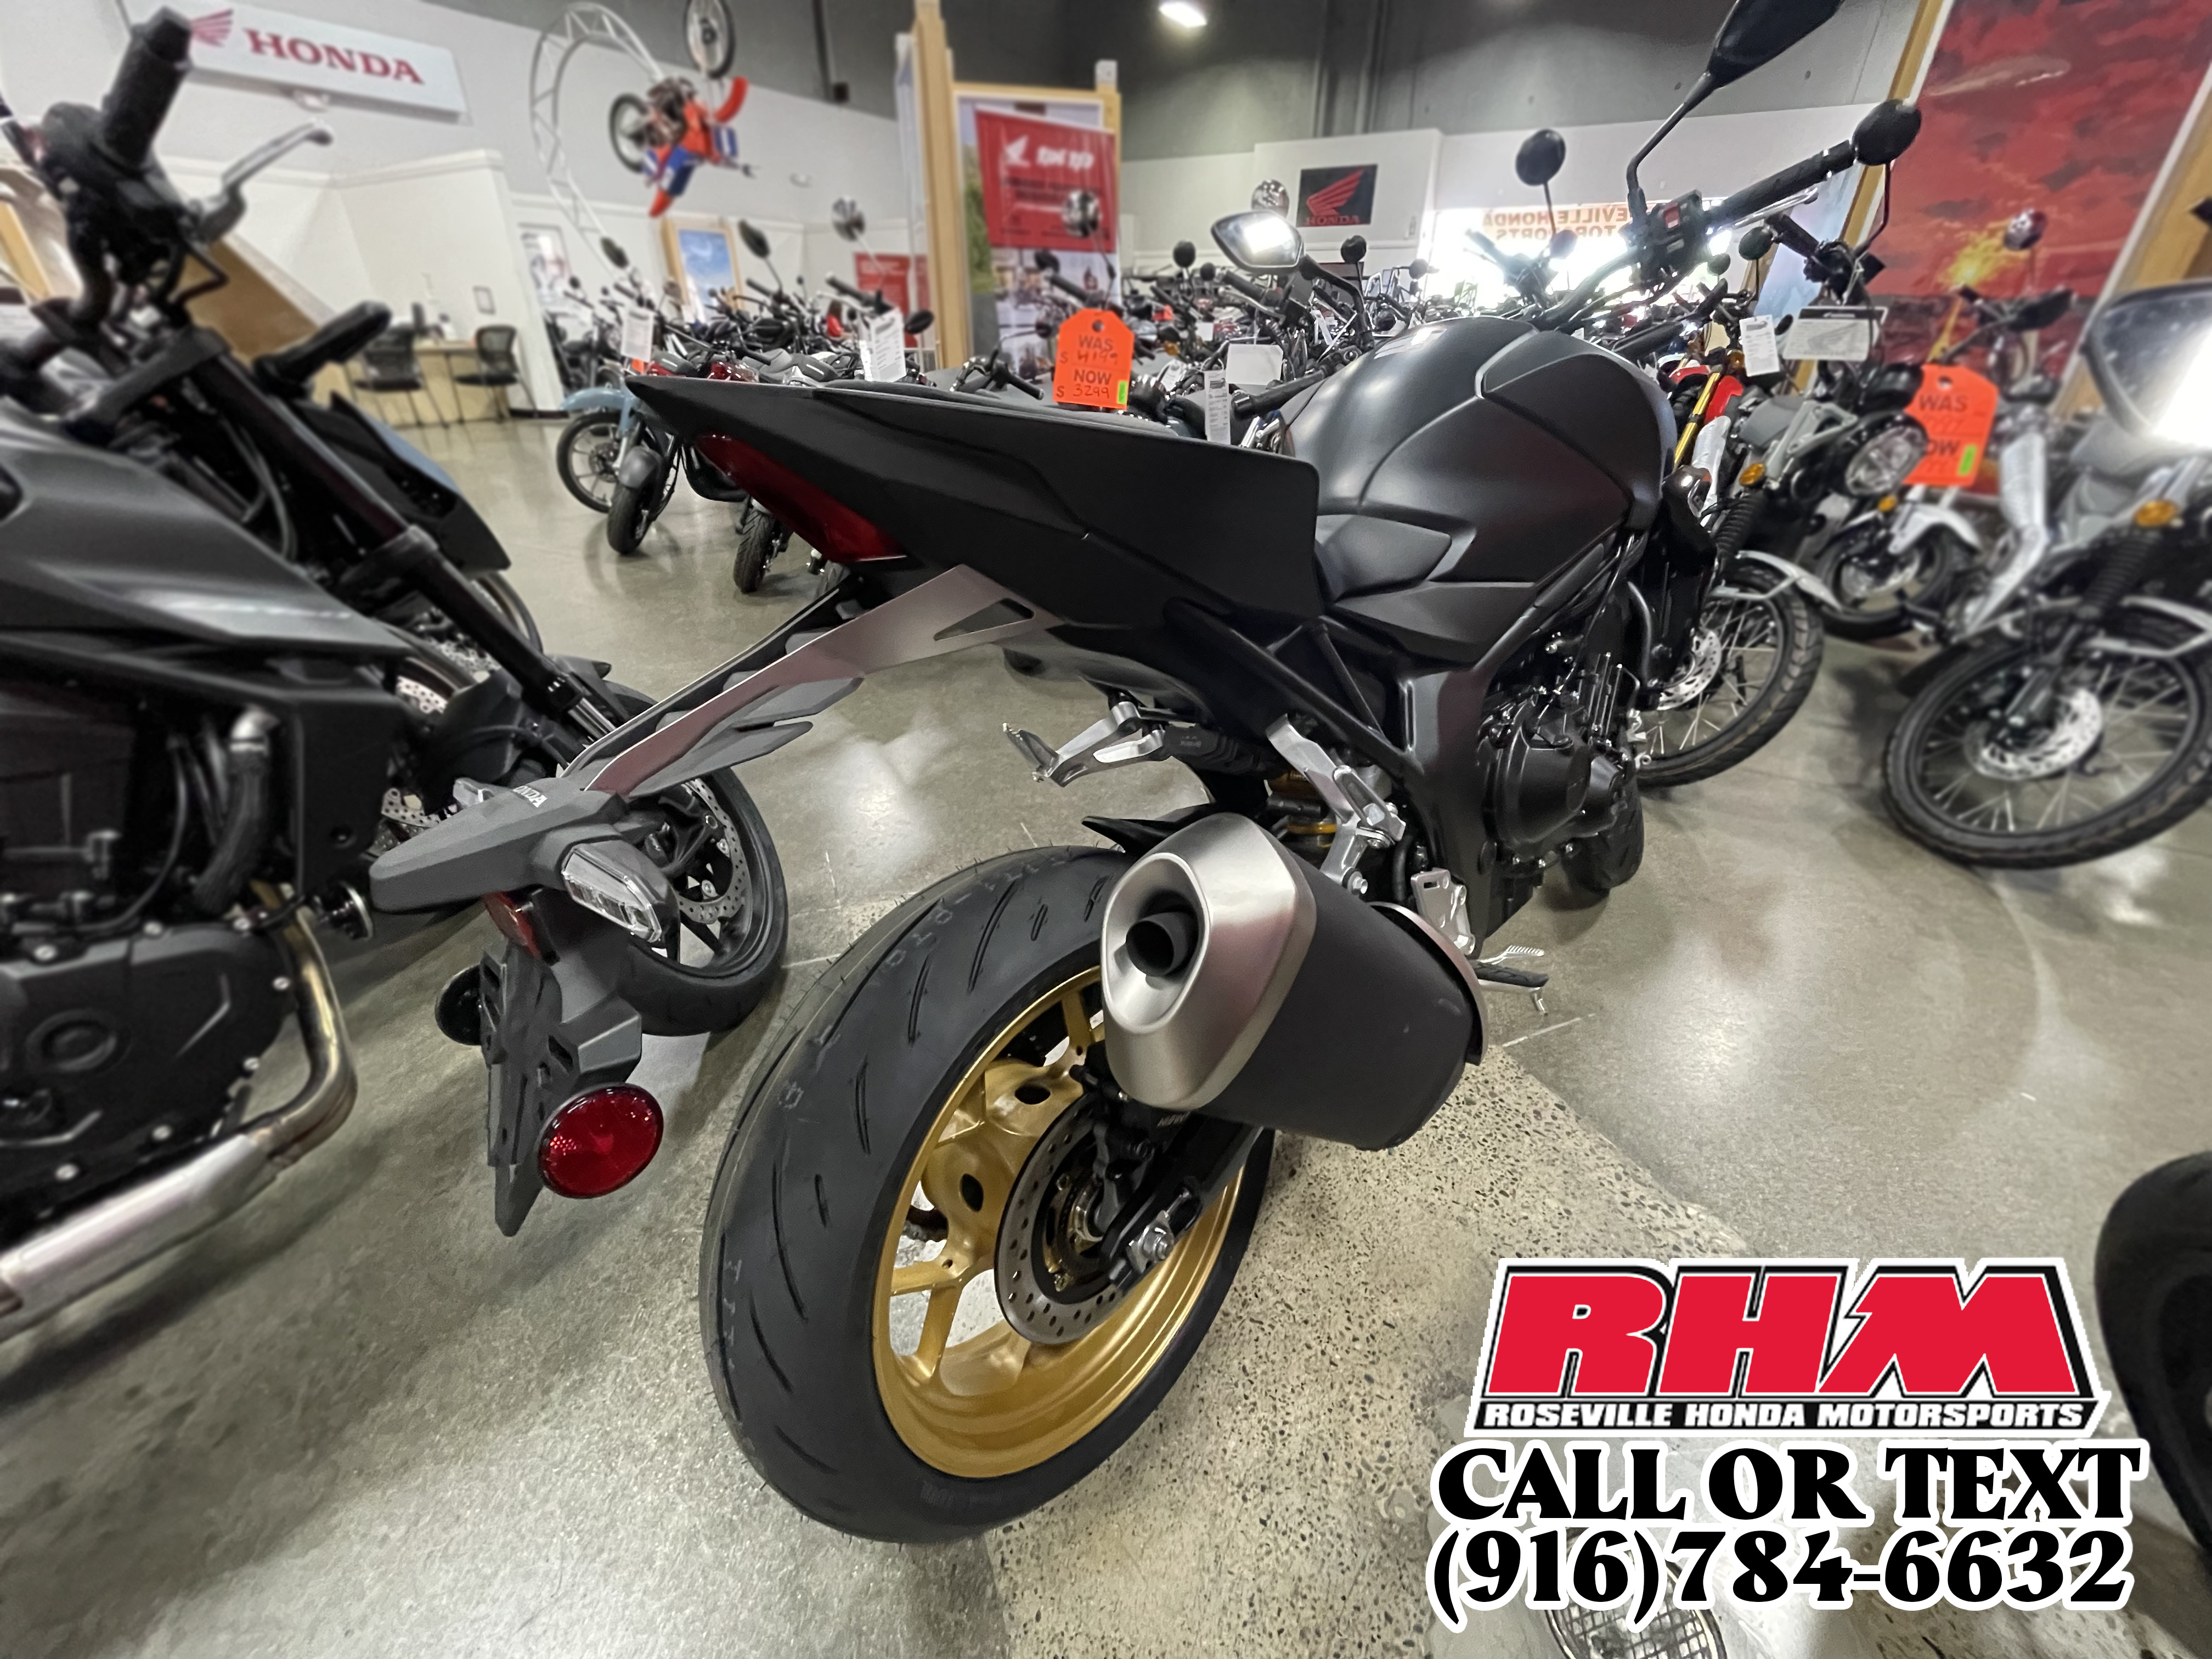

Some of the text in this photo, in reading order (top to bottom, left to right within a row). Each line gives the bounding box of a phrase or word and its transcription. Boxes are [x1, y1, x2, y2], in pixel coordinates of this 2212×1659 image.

[243, 28, 426, 84] HONDA
[1079, 335, 1113, 351] WAS
[1074, 369, 1112, 386] NOW
[1073, 383, 1110, 399] 3299
[1920, 394, 1968, 412] WAS
[1921, 439, 1961, 456] OW
